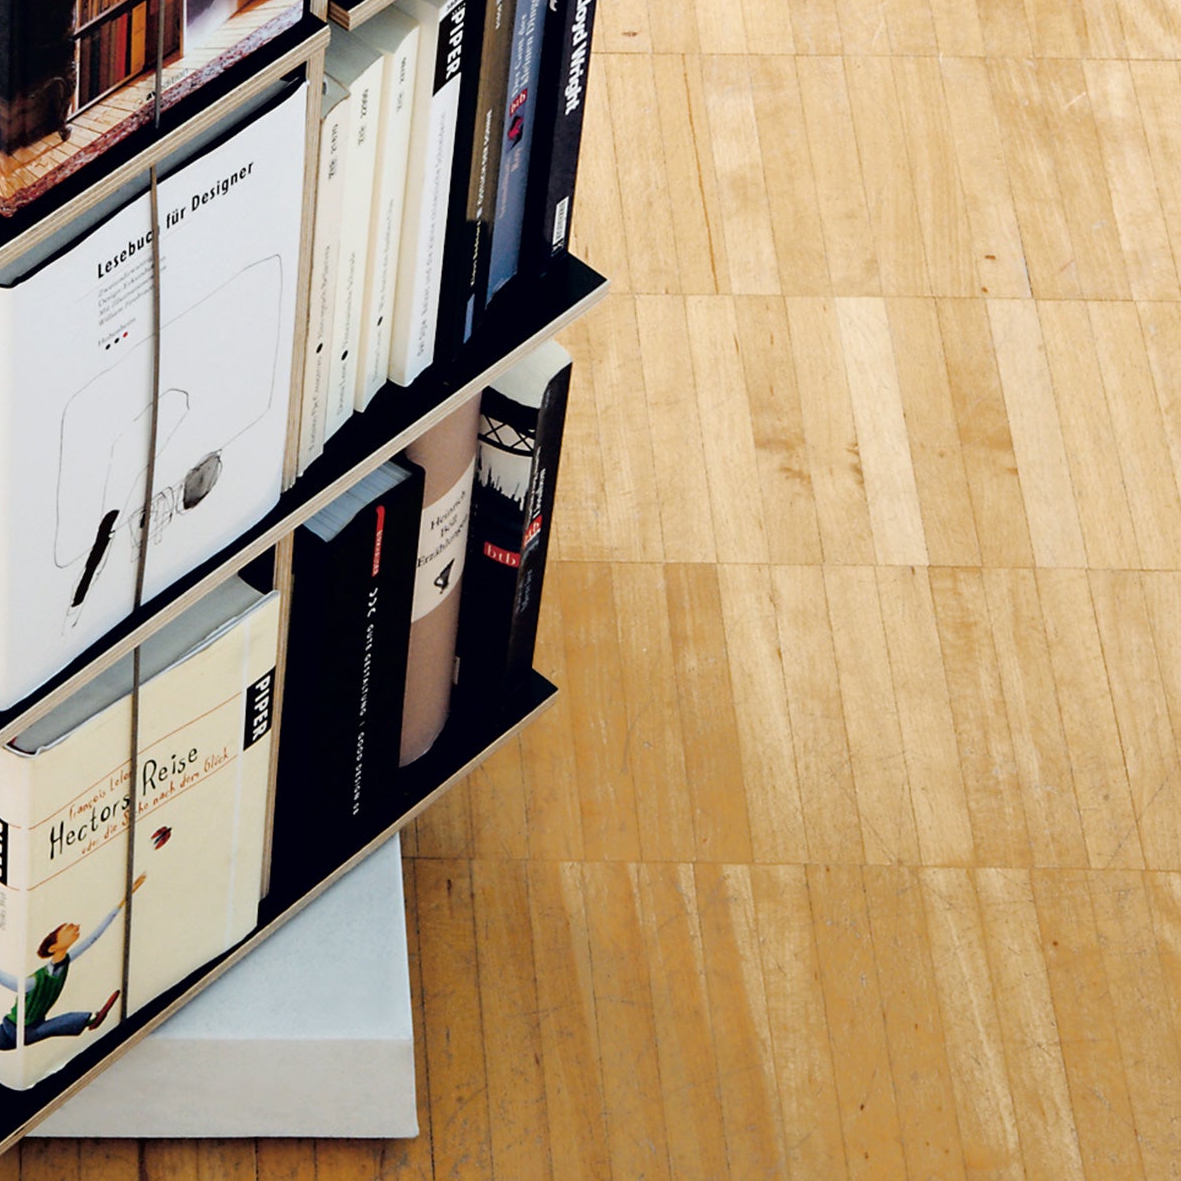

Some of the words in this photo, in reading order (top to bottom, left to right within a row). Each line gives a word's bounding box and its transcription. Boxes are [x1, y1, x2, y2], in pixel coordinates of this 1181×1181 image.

[445, 6, 466, 80] PIPER
[564, 42, 586, 116] Wright
[96, 224, 160, 279] Lesebuc
[165, 207, 186, 229] für
[190, 161, 254, 213] Designer
[488, 543, 517, 566] btb
[252, 674, 270, 741] PIPER
[359, 653, 372, 717] GESTALTUNG
[152, 780, 176, 804] nach
[179, 771, 200, 791] dem
[203, 746, 229, 772] Glück
[355, 730, 365, 763] GOOD
[49, 793, 131, 860] Hectors
[142, 747, 199, 796] Reise
